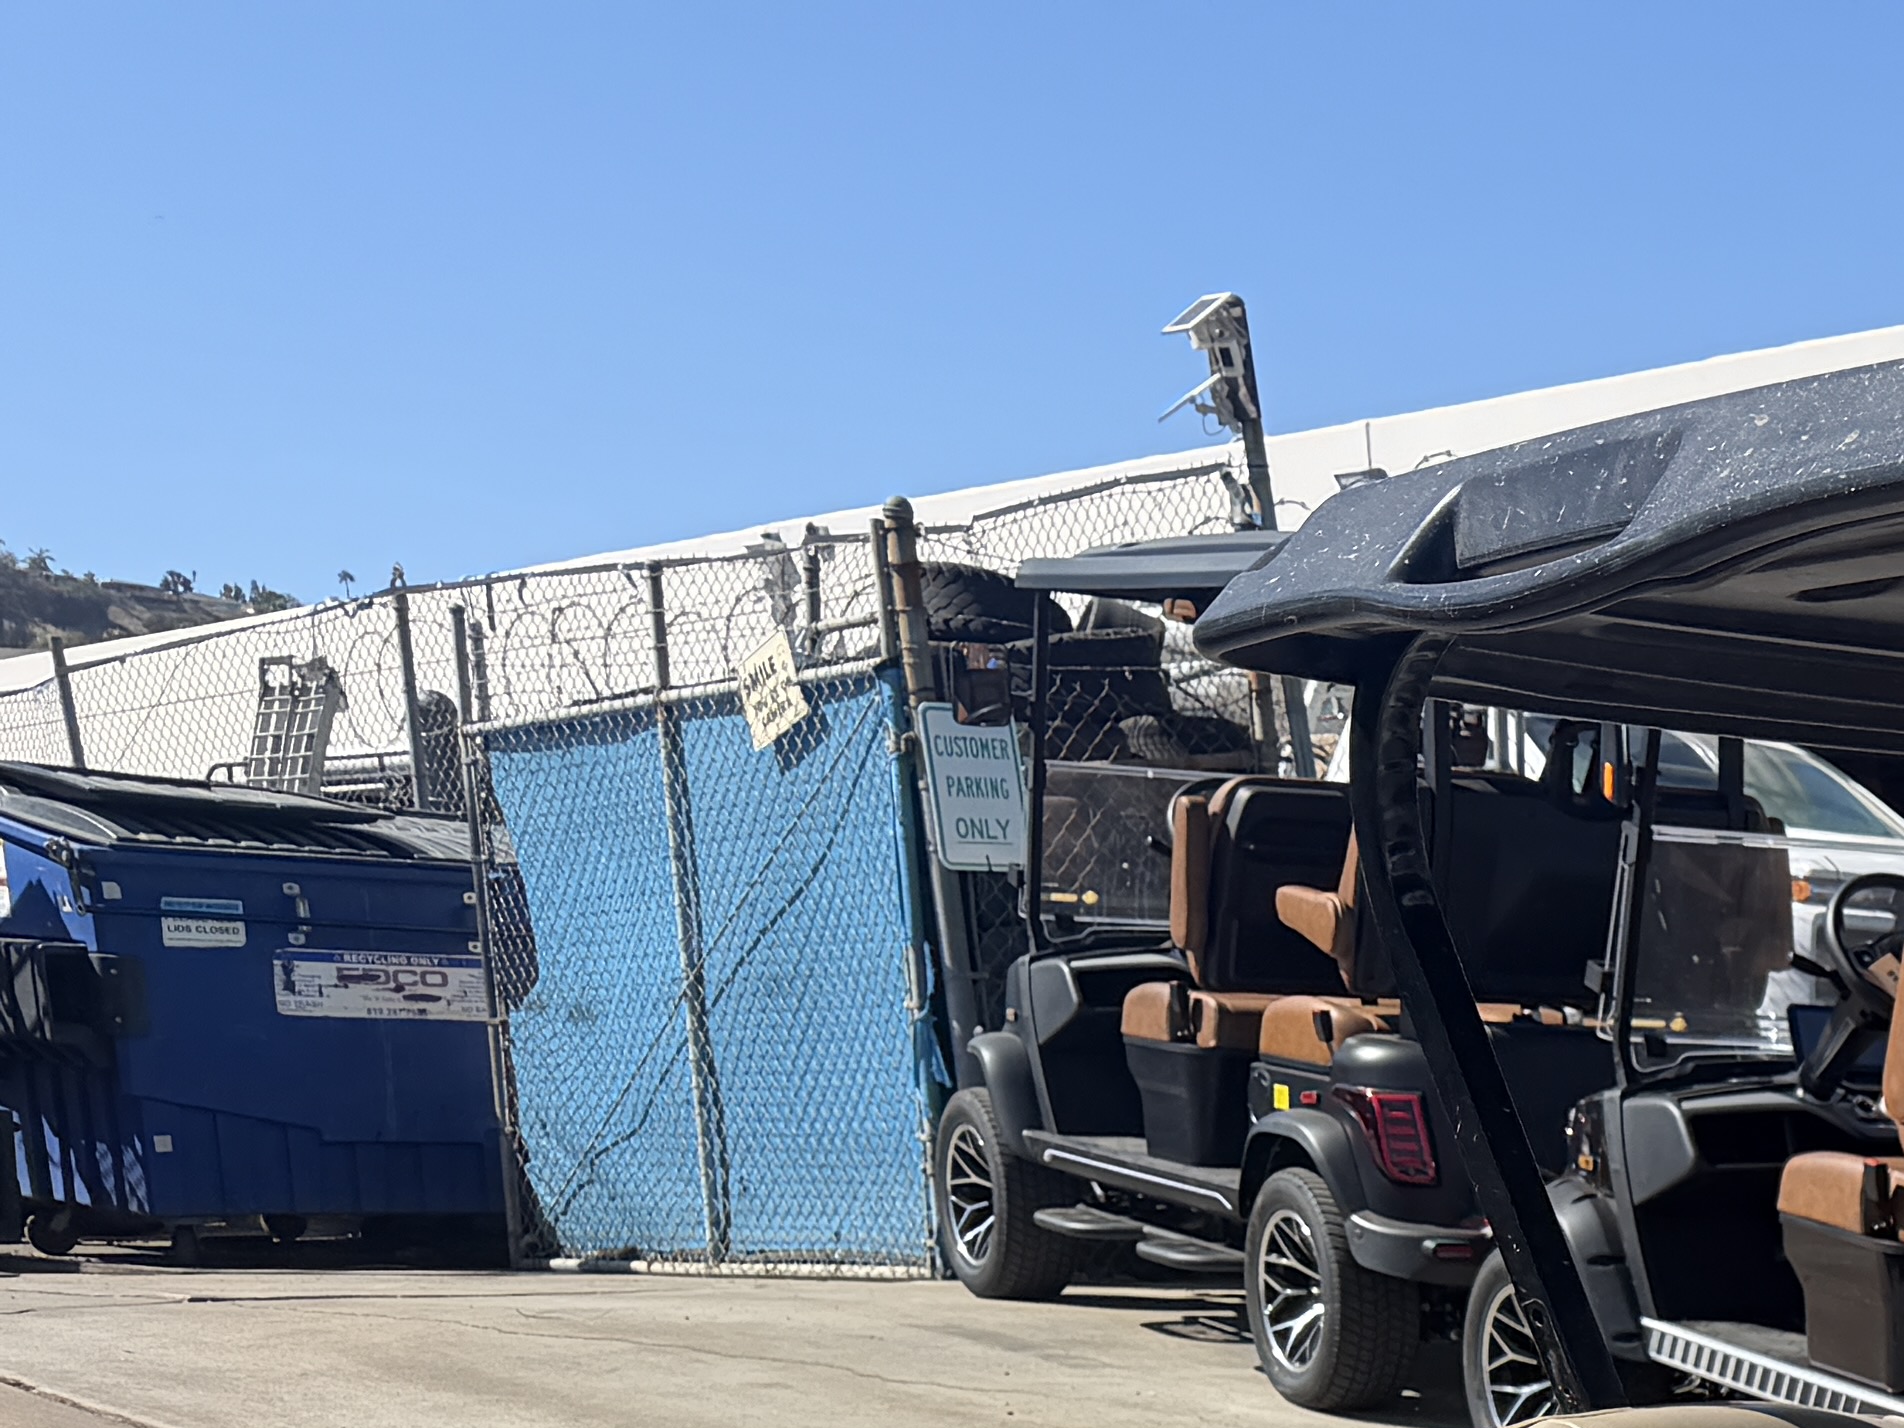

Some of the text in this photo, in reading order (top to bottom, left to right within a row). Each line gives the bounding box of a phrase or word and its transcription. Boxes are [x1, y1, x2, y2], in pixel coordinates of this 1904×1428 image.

[743, 655, 777, 699] SMILE
[933, 735, 1010, 760] CUSTOMER
[946, 776, 1010, 800] PARKING
[956, 817, 1010, 840] ONLY
[167, 924, 240, 935] LIDS CLOSED
[343, 953, 440, 966] RECYCLING ONLY
